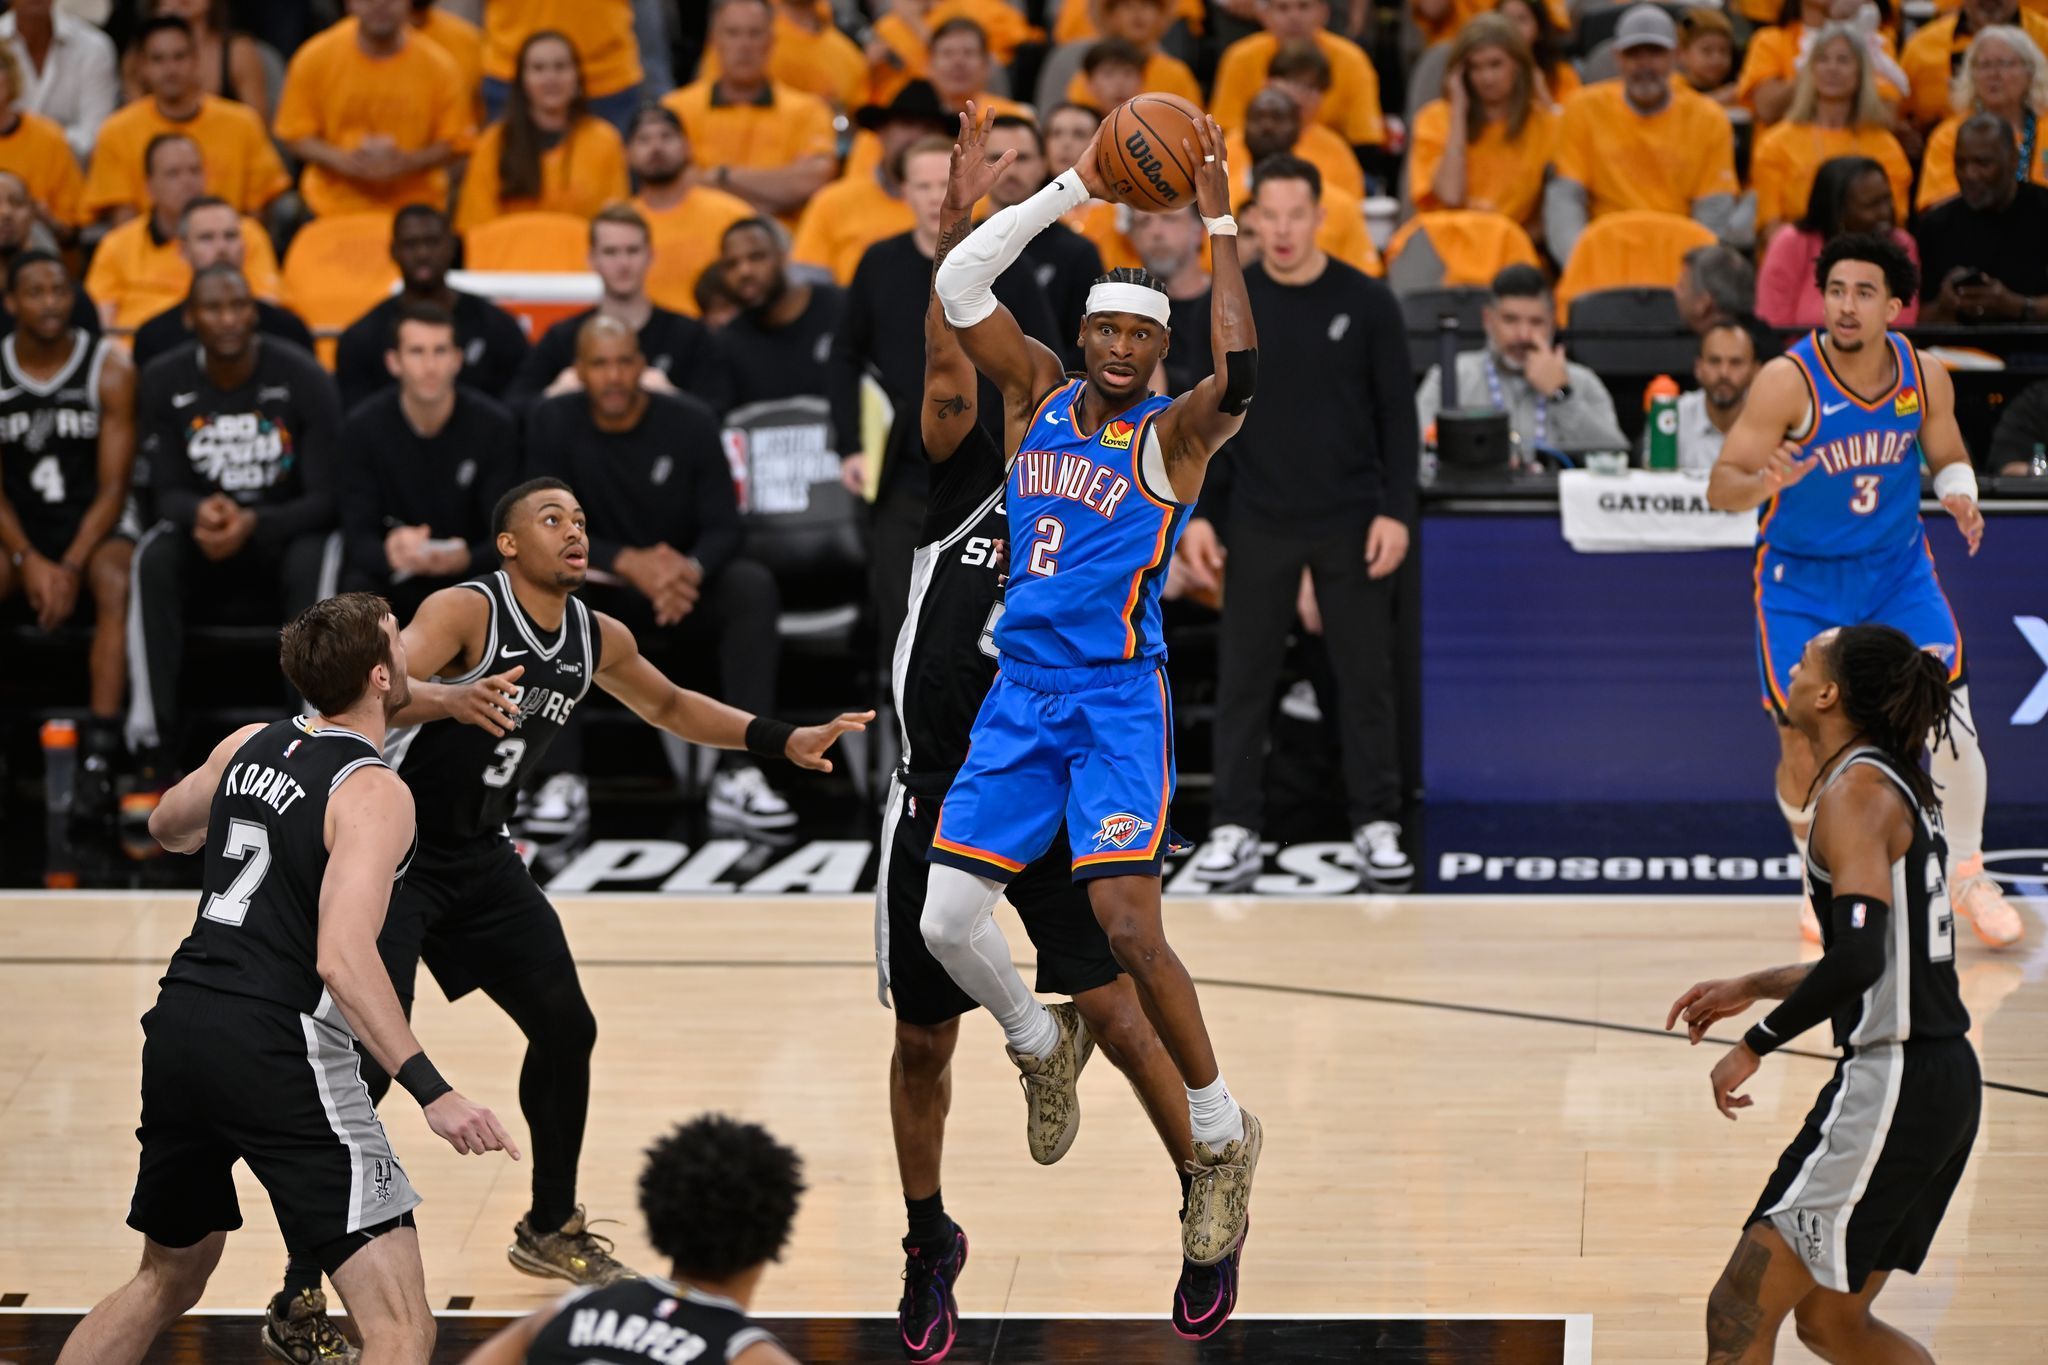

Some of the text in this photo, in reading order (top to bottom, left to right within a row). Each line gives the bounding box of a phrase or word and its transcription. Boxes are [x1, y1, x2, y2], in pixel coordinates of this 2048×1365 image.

[1125, 130, 1179, 202] Wilson
[1813, 430, 1914, 476] THUNDE
[30, 455, 65, 503] 4
[1017, 450, 1131, 521] THUNDER
[1849, 475, 1883, 515] 3
[1598, 493, 1738, 516] GATORA
[1027, 516, 1066, 577] 2
[481, 738, 527, 788] 3
[225, 762, 306, 815] KORNET
[1102, 820, 1132, 841] OKC
[202, 817, 272, 927] 7
[1438, 852, 1803, 881] Presented
[568, 1308, 707, 1365] HARPER
